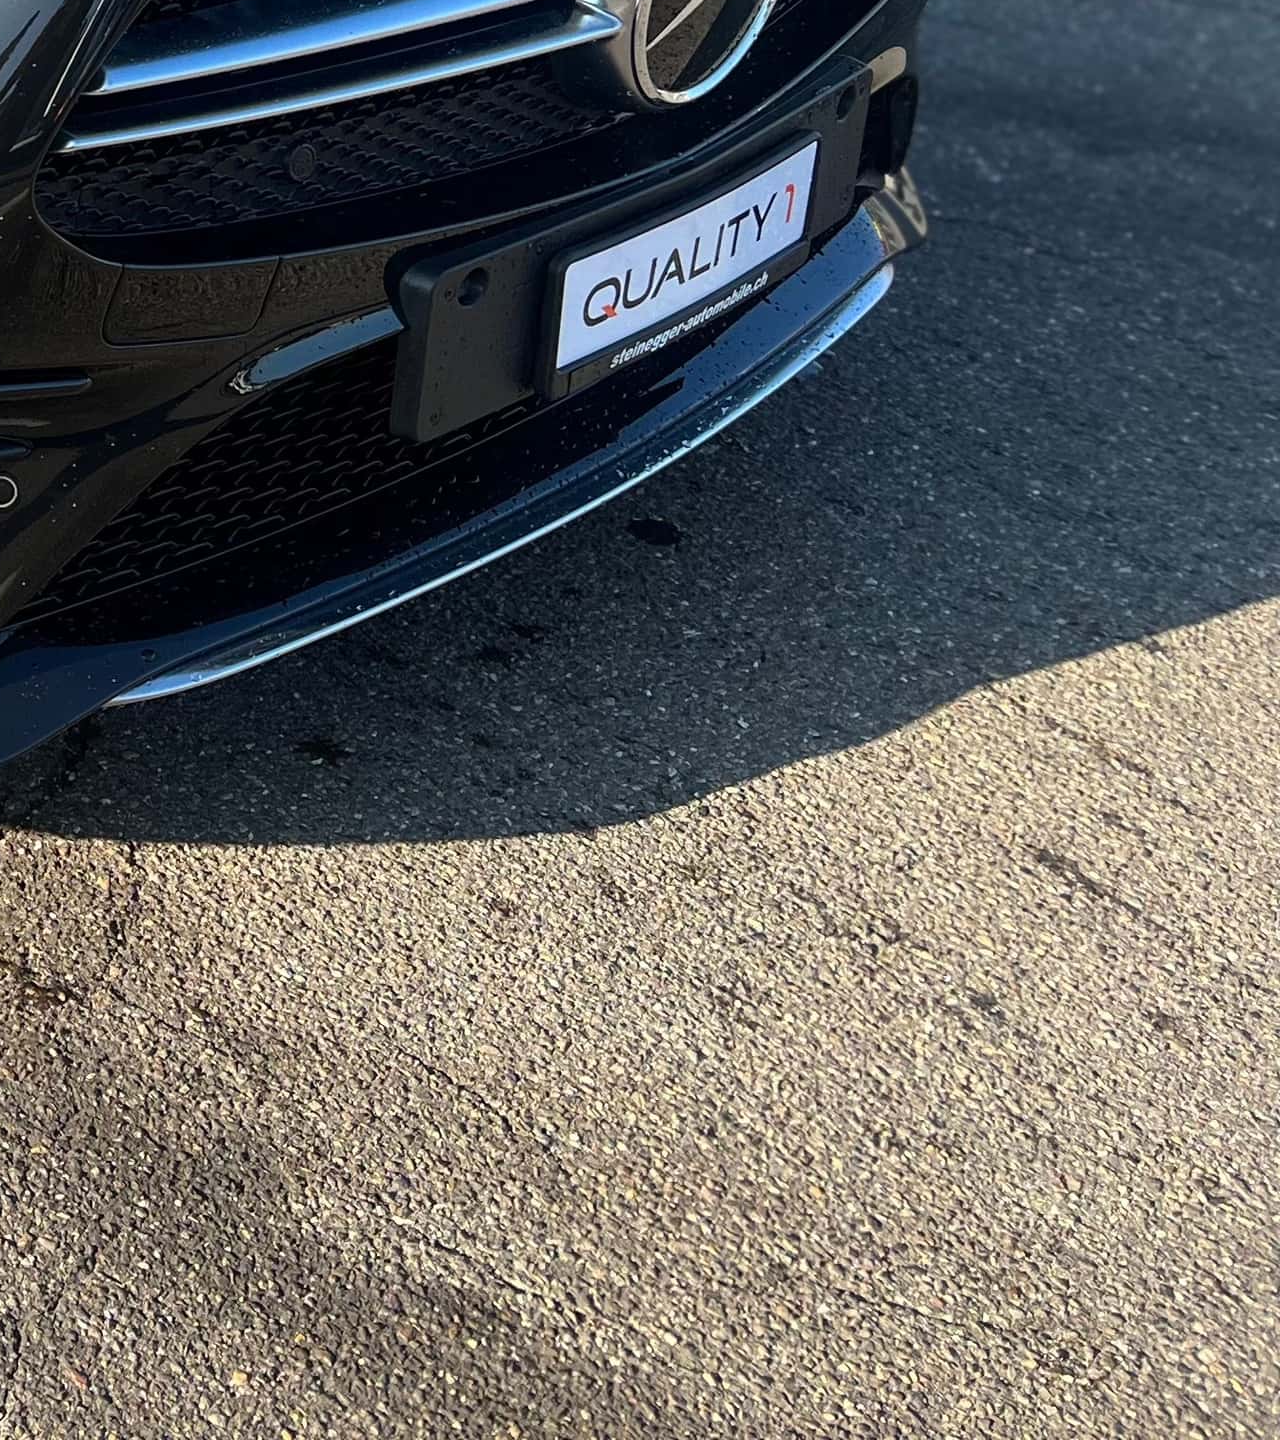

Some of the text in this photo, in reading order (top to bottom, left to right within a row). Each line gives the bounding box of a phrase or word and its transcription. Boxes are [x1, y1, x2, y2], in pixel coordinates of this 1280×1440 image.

[583, 184, 795, 327] QUALITY 1
[610, 271, 769, 369] steinegger-automobile.ch
